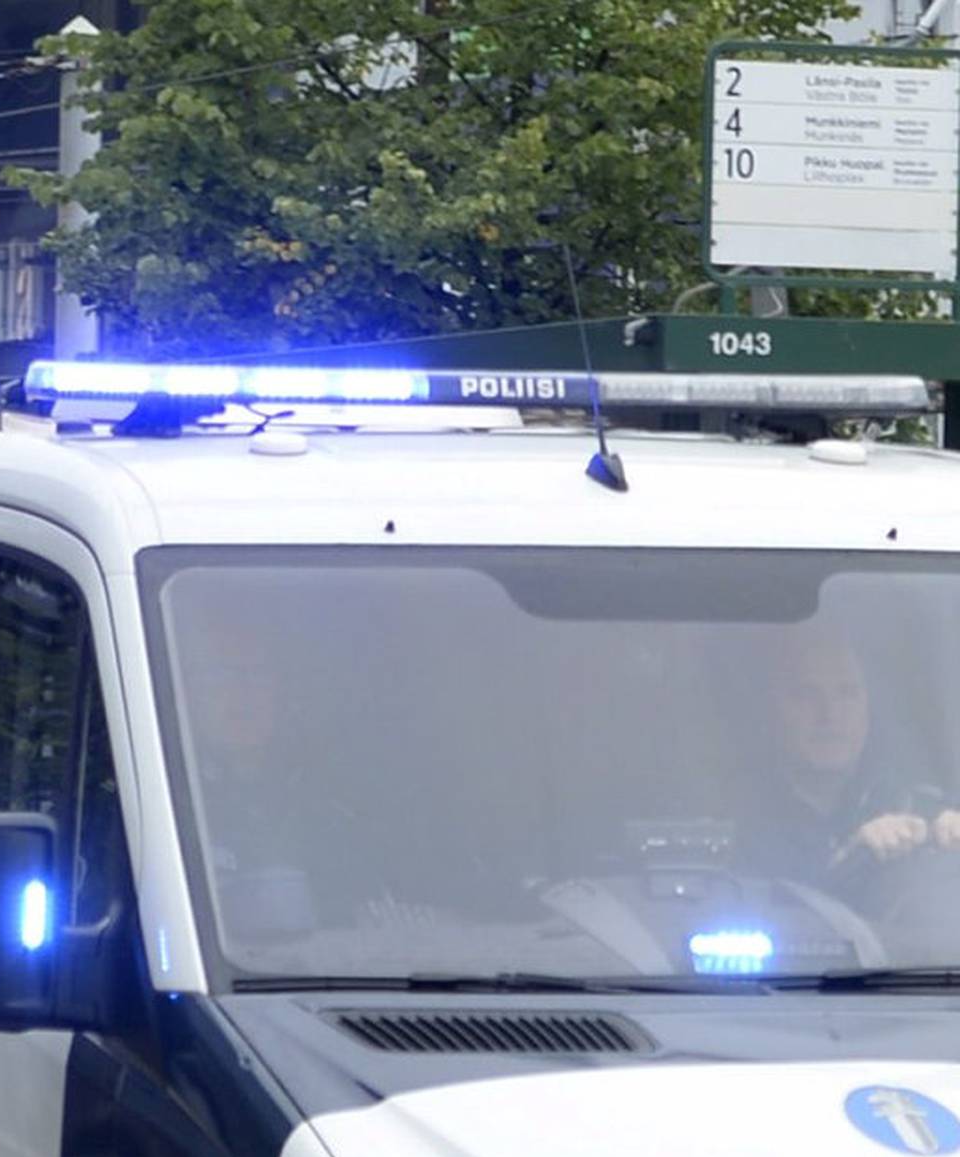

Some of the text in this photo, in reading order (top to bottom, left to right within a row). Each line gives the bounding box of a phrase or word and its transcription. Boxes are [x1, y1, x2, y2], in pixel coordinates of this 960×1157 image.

[726, 67, 741, 97] 2
[725, 108, 743, 137] 4
[724, 148, 755, 179] 10
[709, 332, 771, 355] 1043
[460, 377, 566, 398] POLIISI
